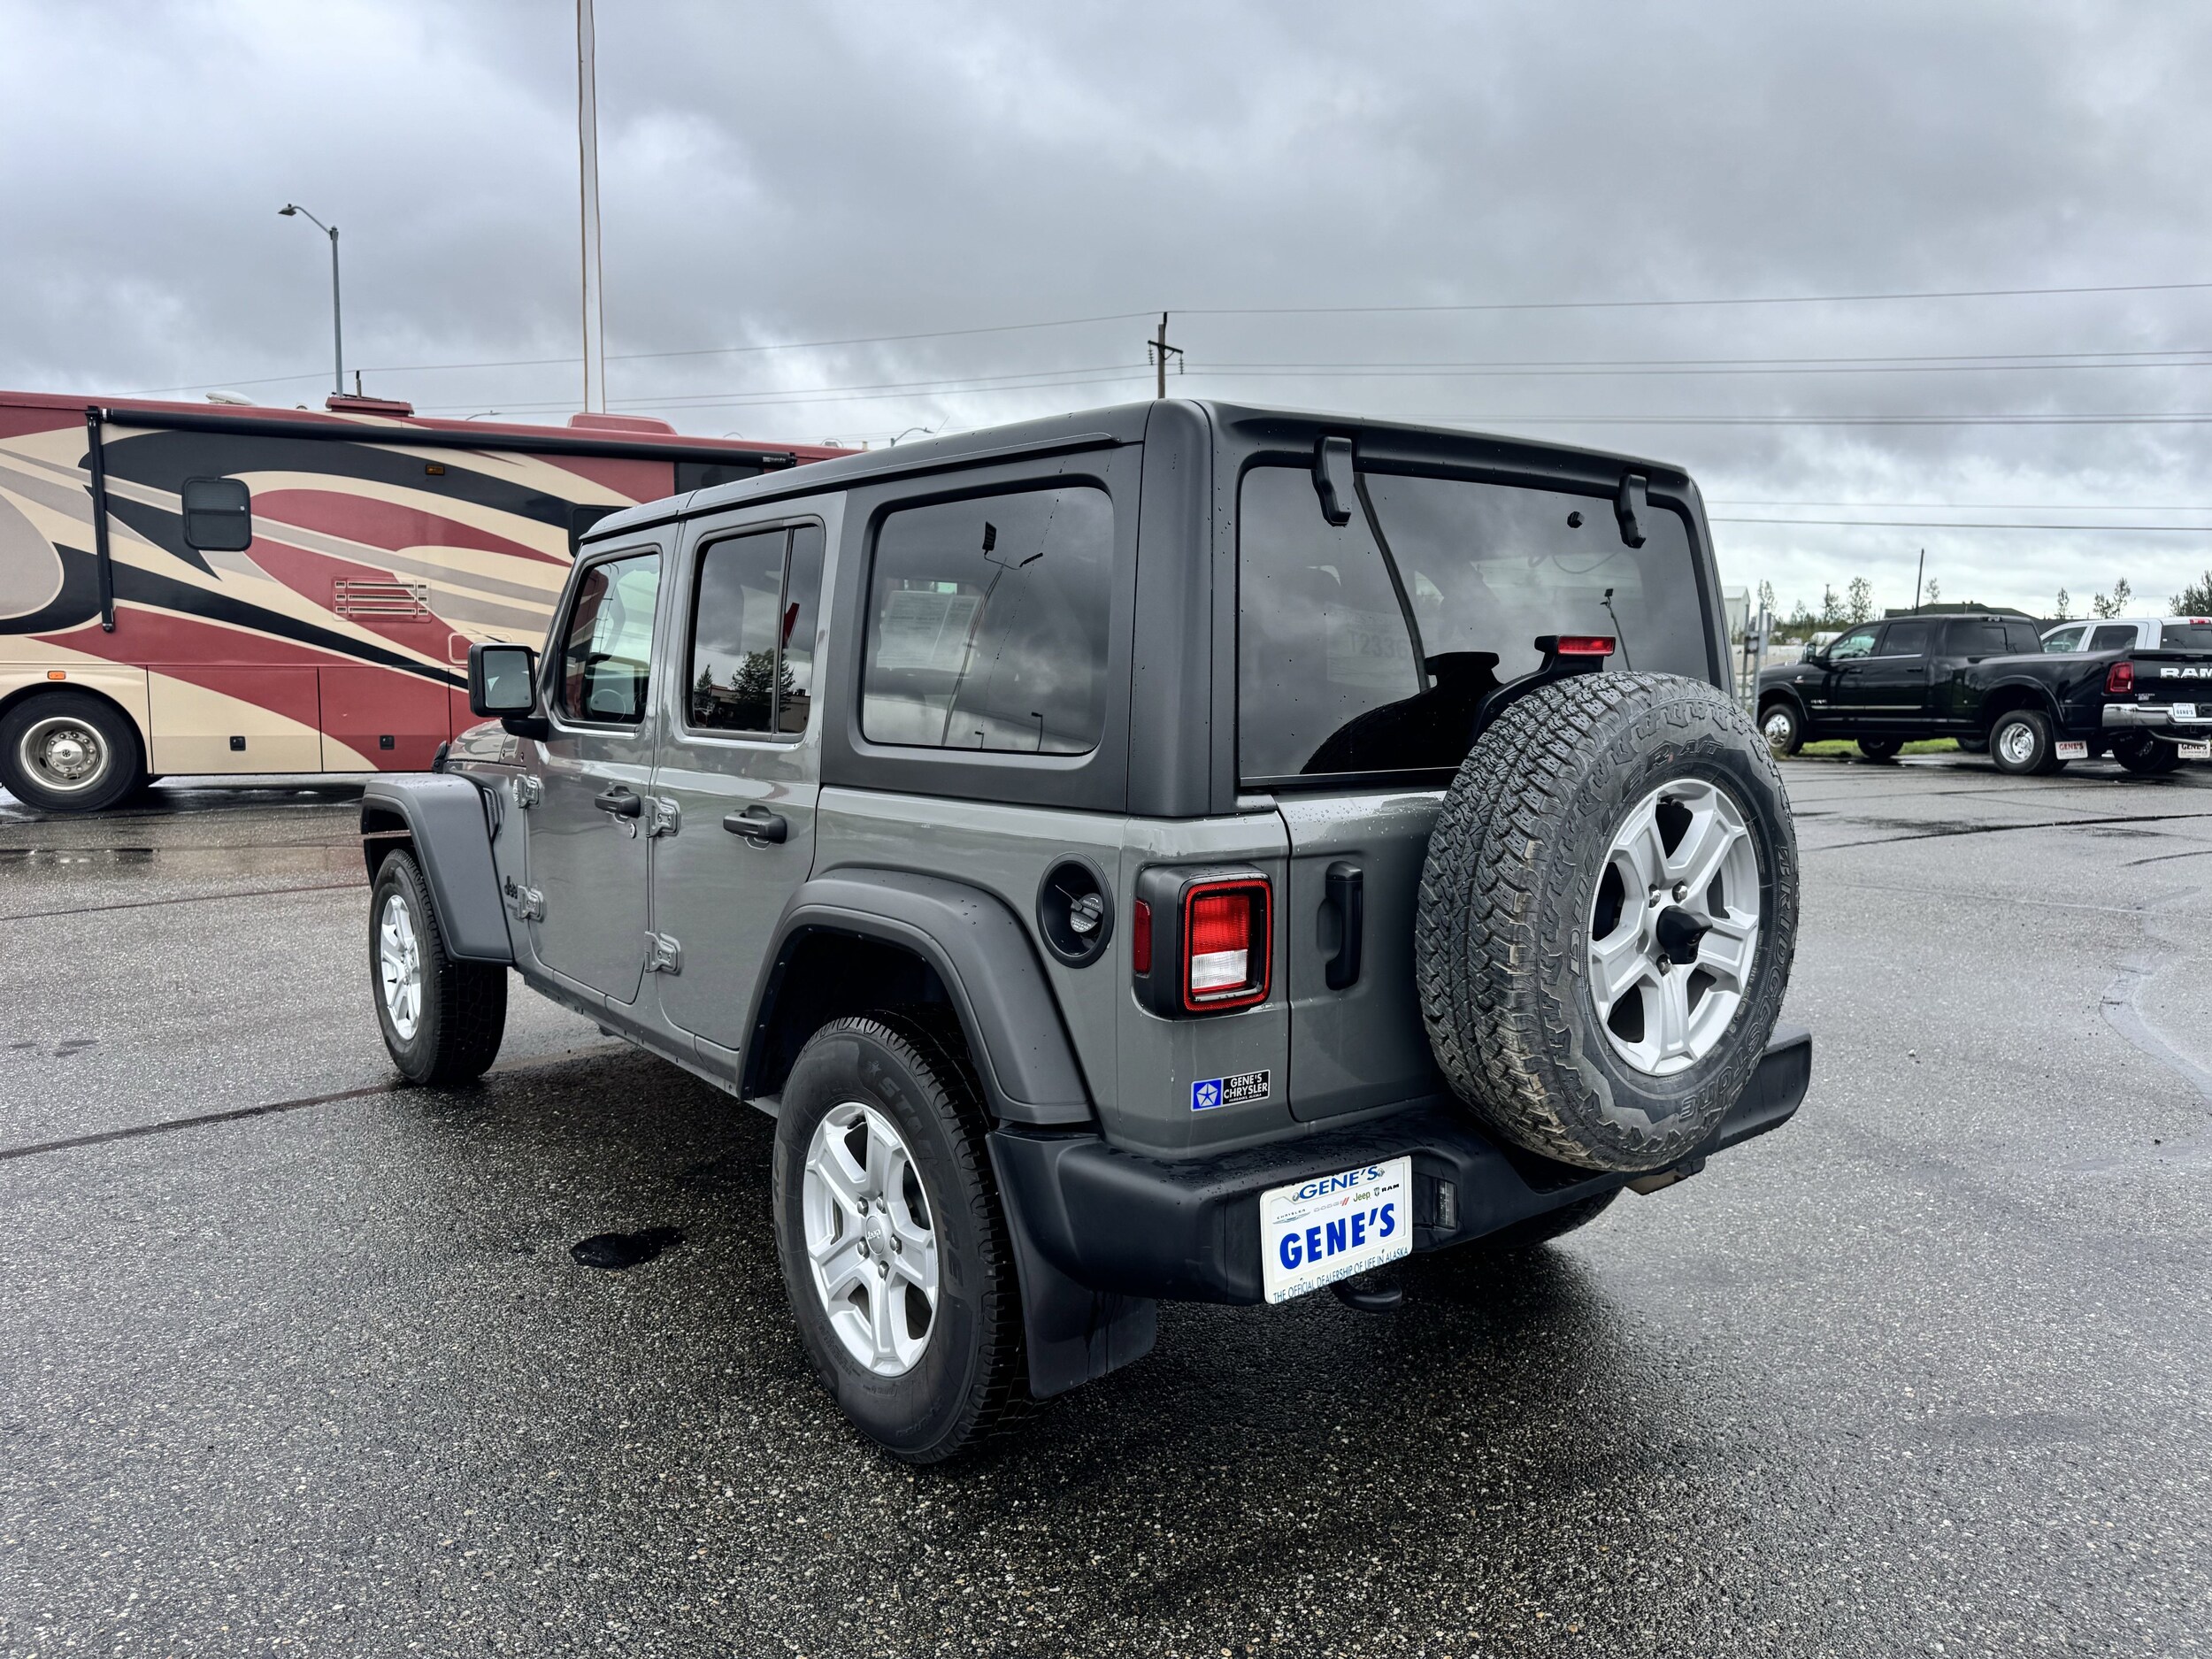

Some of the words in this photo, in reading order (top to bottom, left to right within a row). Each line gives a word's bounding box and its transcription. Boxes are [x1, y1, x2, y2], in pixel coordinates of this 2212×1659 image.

[2160, 667, 2212, 679] RAM
[1230, 1073, 1263, 1088] GENE'S
[1223, 1082, 1268, 1099] CHRYSLER
[1299, 1165, 1379, 1200] GENE'S
[1381, 1183, 1400, 1193] RAM
[1353, 1190, 1371, 1202] Jeep
[1277, 1209, 1306, 1220] CHRYSLER
[1279, 1202, 1395, 1270] GENE'S
[1273, 1288, 1286, 1303] THE
[1287, 1279, 1315, 1298] OFFICIAL
[1317, 1265, 1353, 1286] DEALERSHIP
[1354, 1261, 1363, 1272] OF
[1364, 1256, 1375, 1268] LIFE
[1377, 1255, 1384, 1265] IN
[1385, 1246, 1409, 1262] ALASKA
